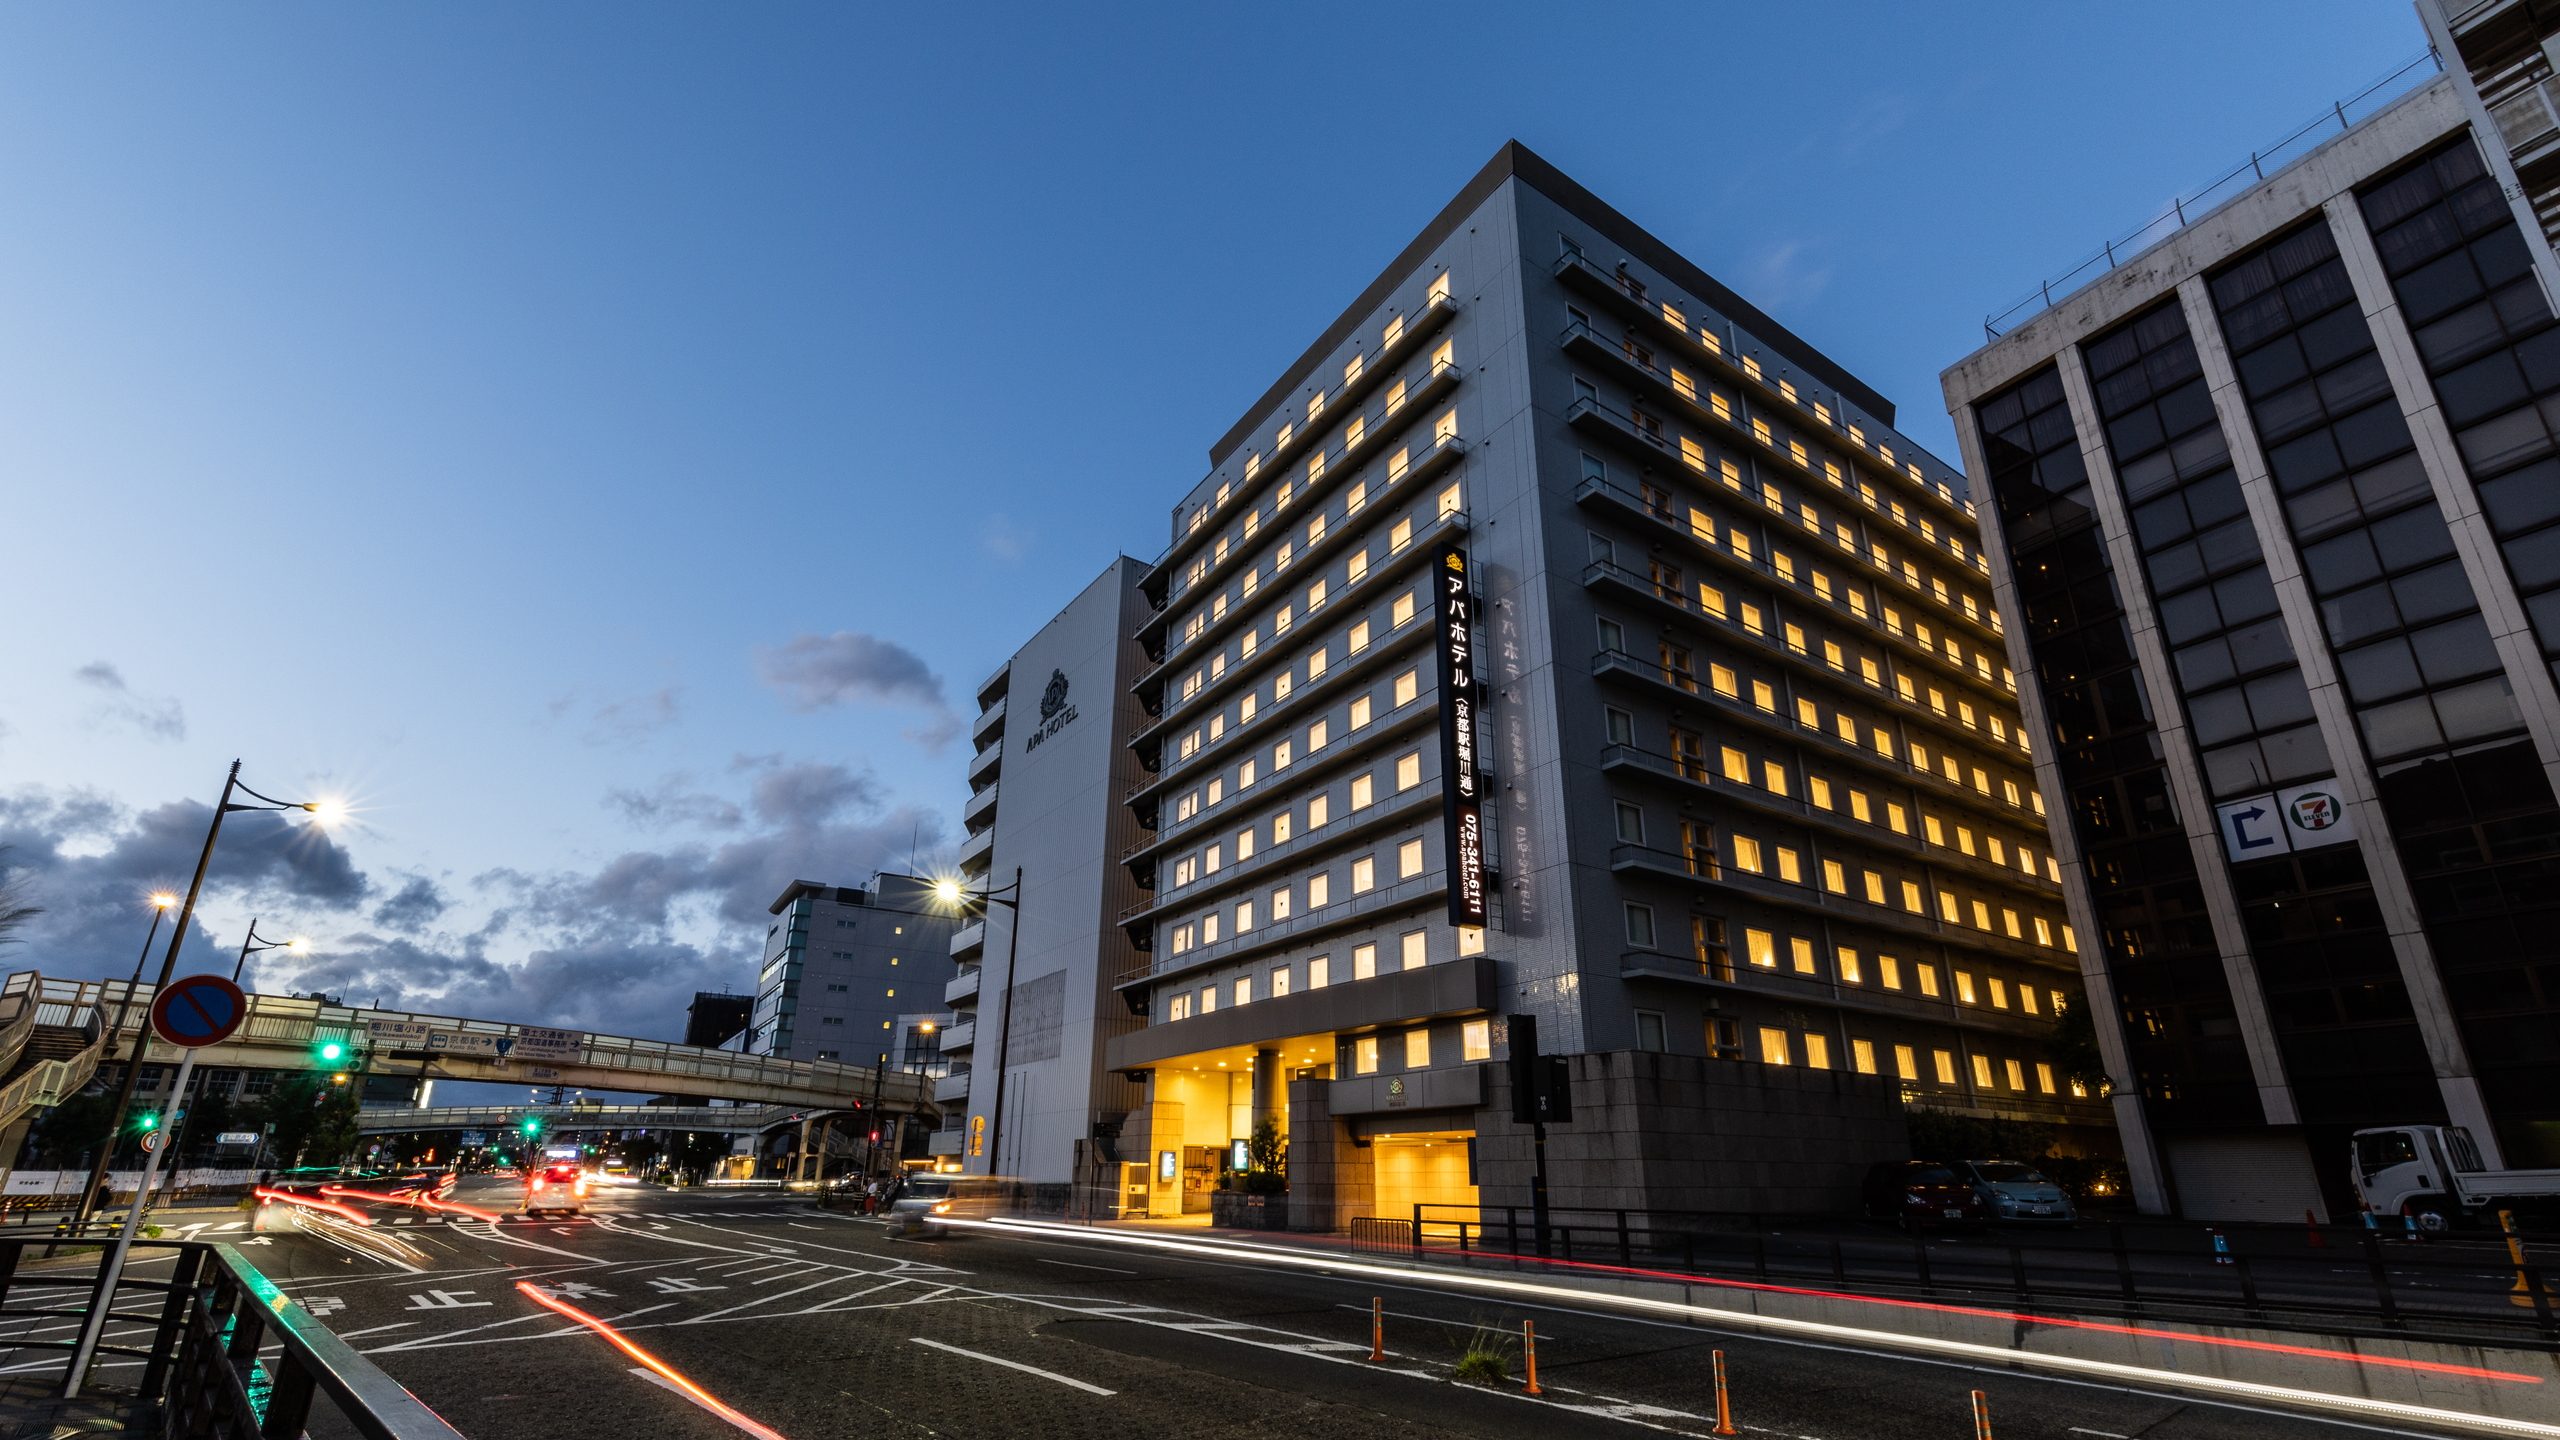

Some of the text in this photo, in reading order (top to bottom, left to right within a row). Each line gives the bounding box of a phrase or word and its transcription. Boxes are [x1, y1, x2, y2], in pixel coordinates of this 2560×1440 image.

[1448, 576, 1469, 687] アパホテル
[1026, 704, 1079, 754] APA HOTEL
[1460, 826, 1470, 899] www.apahotel.com
[1465, 814, 1482, 914] 075-341-6111
[370, 1021, 427, 1035] 堀川塩小路
[521, 1028, 566, 1039] 国土交通省
[371, 1031, 421, 1040] Horikawashiokoji
[448, 1035, 480, 1046] 京都駅
[520, 1037, 568, 1048] 京都国道事務所
